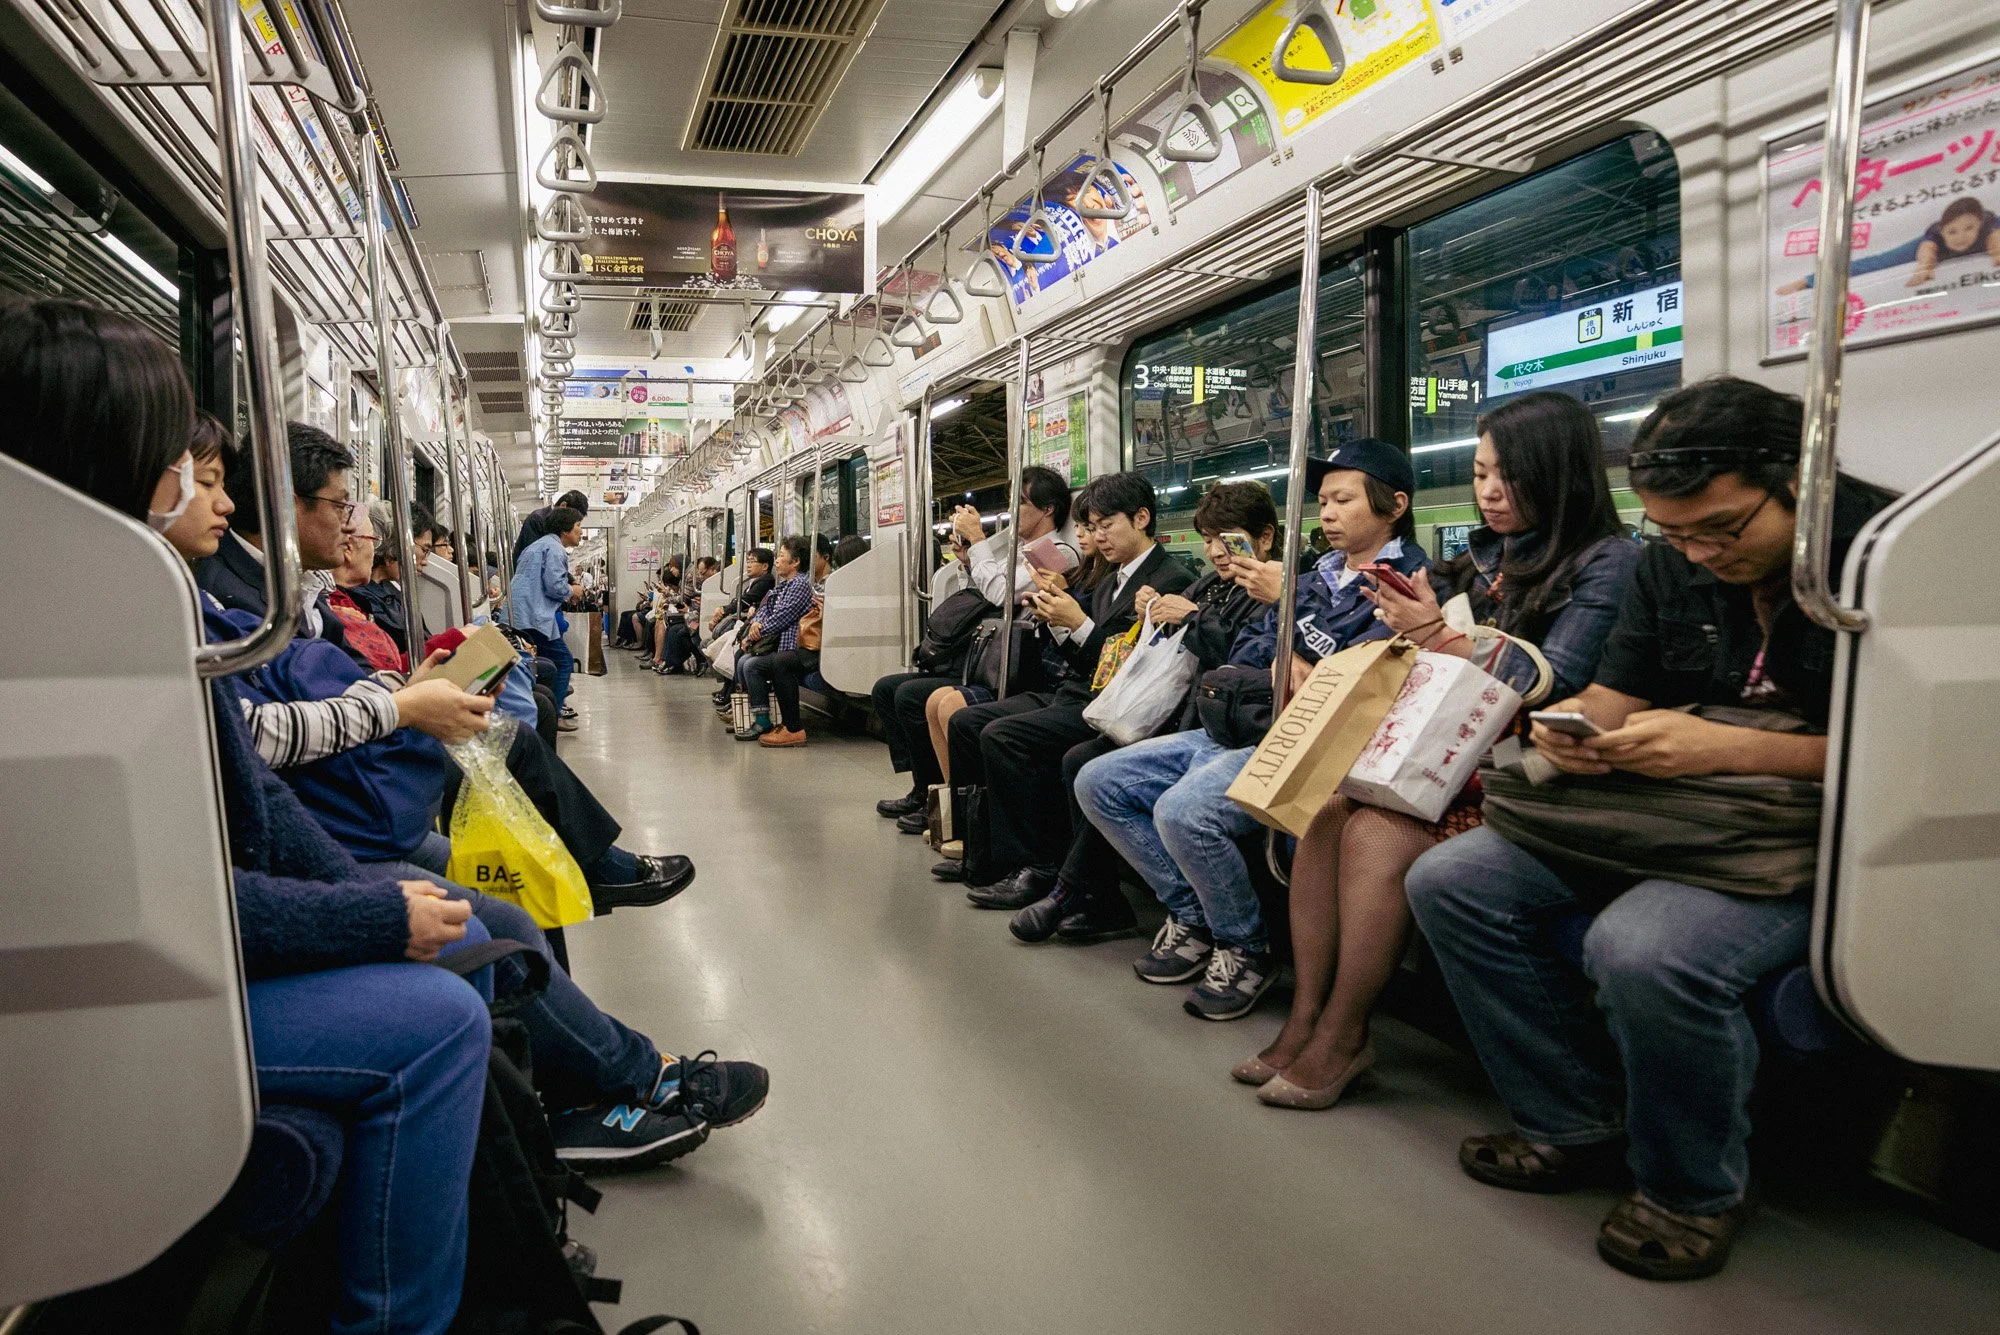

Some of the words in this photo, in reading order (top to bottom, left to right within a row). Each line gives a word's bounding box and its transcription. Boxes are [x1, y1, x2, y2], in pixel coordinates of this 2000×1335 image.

[805, 228, 858, 242] CHOYA
[1612, 288, 1679, 323] 新宿
[1584, 309, 1597, 318] SJK
[1585, 326, 1596, 336] 10
[1627, 317, 1663, 333] しんじゅく
[1622, 350, 1666, 366] Shinjuku
[1513, 359, 1545, 377] 代々木
[1134, 364, 1149, 389] 3
[1205, 376, 1232, 385] 千葉方面
[1410, 376, 1426, 386] 渋谷
[1410, 386, 1426, 395] 方面
[1438, 378, 1468, 391] 山手線
[1471, 380, 1480, 403] 1
[1438, 391, 1468, 400] Yamanote
[1437, 399, 1451, 407] Line
[1247, 665, 1345, 789] AUTHORITY
[602, 1103, 647, 1132] N
